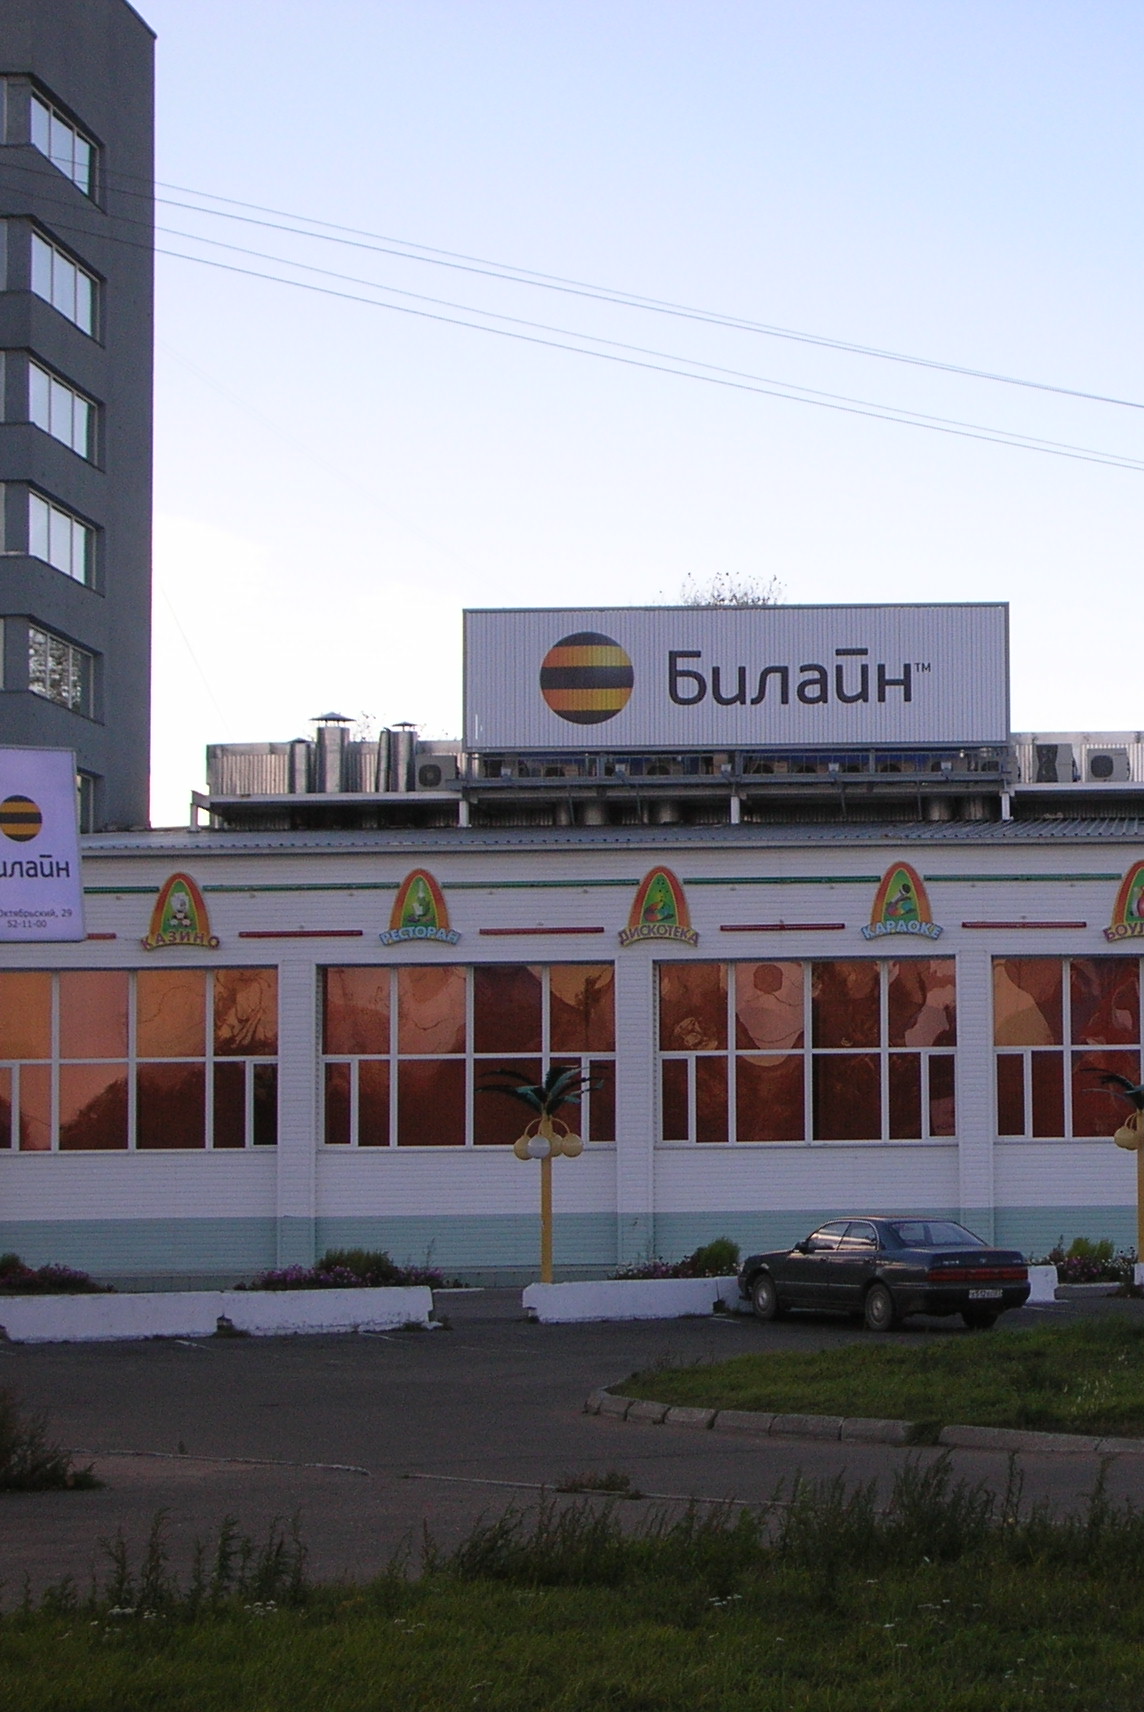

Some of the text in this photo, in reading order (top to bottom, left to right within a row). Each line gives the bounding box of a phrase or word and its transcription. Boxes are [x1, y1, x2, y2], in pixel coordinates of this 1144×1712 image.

[668, 648, 912, 706] Билайн
[61, 908, 73, 918] 29
[7, 920, 47, 928] 52-11-00
[860, 920, 943, 940] КАРАОКЕ
[141, 931, 220, 951] КАЗИНО
[379, 926, 462, 945] РЕСТОРАН
[618, 924, 699, 947] ДИСКОТЕКА
